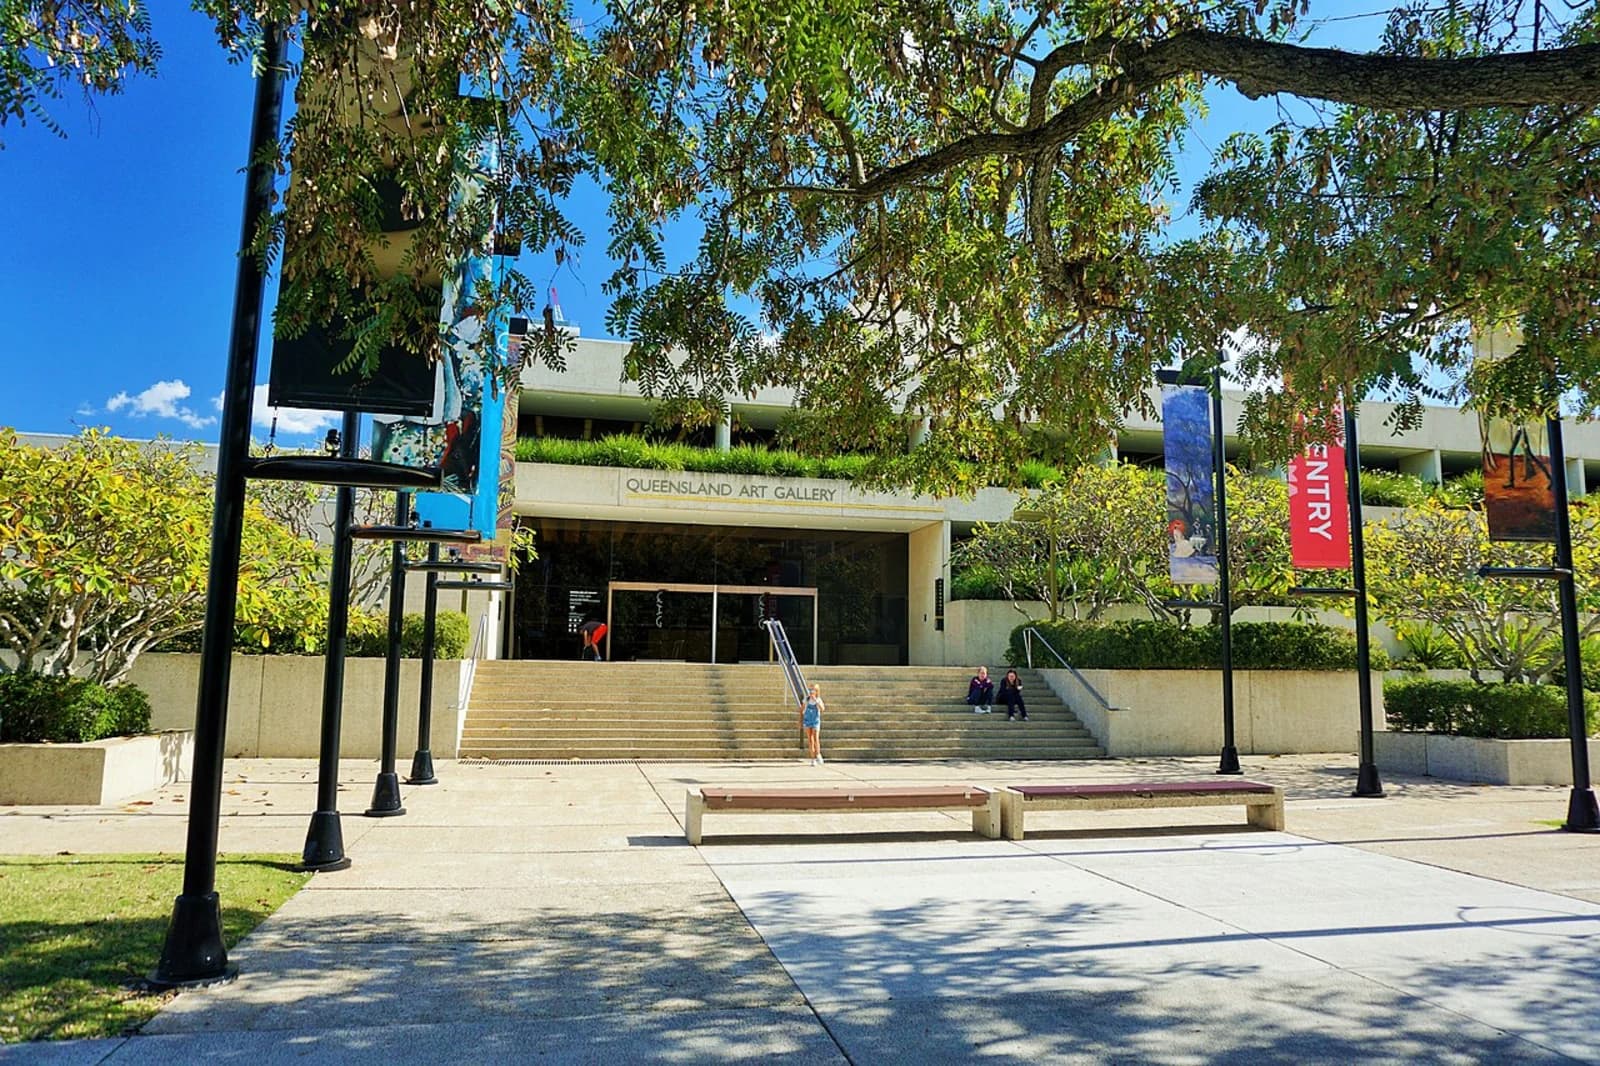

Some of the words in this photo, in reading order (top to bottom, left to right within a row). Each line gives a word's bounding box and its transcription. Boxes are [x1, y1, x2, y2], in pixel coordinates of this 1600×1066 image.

[626, 478, 733, 497] QUEENSLAND
[739, 484, 769, 498] ART
[774, 486, 837, 501] GALLERY
[1305, 441, 1332, 540] ENTRY
